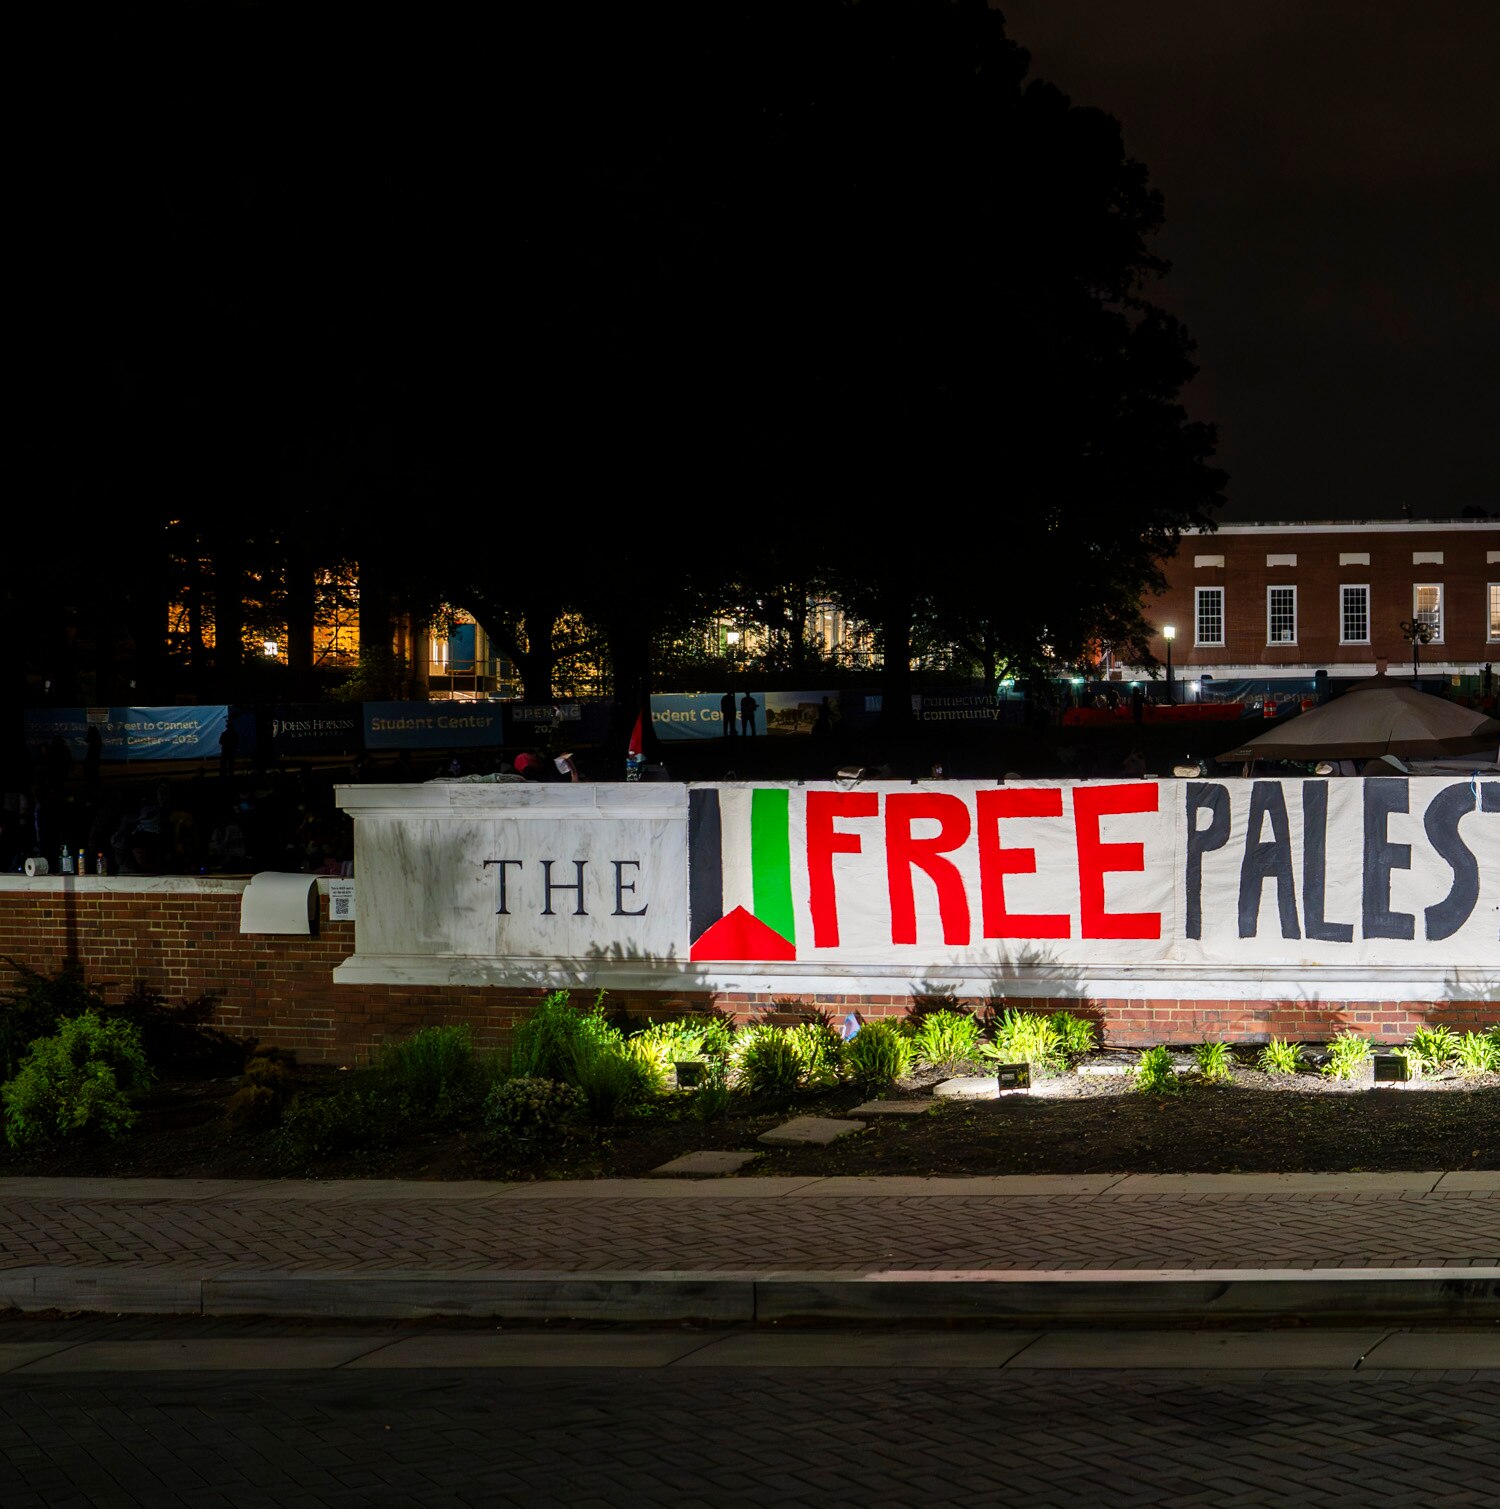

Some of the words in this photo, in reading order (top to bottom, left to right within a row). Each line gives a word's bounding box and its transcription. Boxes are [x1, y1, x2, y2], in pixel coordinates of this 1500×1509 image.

[511, 707, 580, 720] OPENNG
[651, 708, 697, 722] udent
[700, 708, 742, 721] Cee
[923, 707, 1000, 720] community
[371, 716, 433, 731] Student
[436, 714, 494, 729] Center
[805, 782, 1162, 949] FREE
[483, 859, 649, 916] THE
